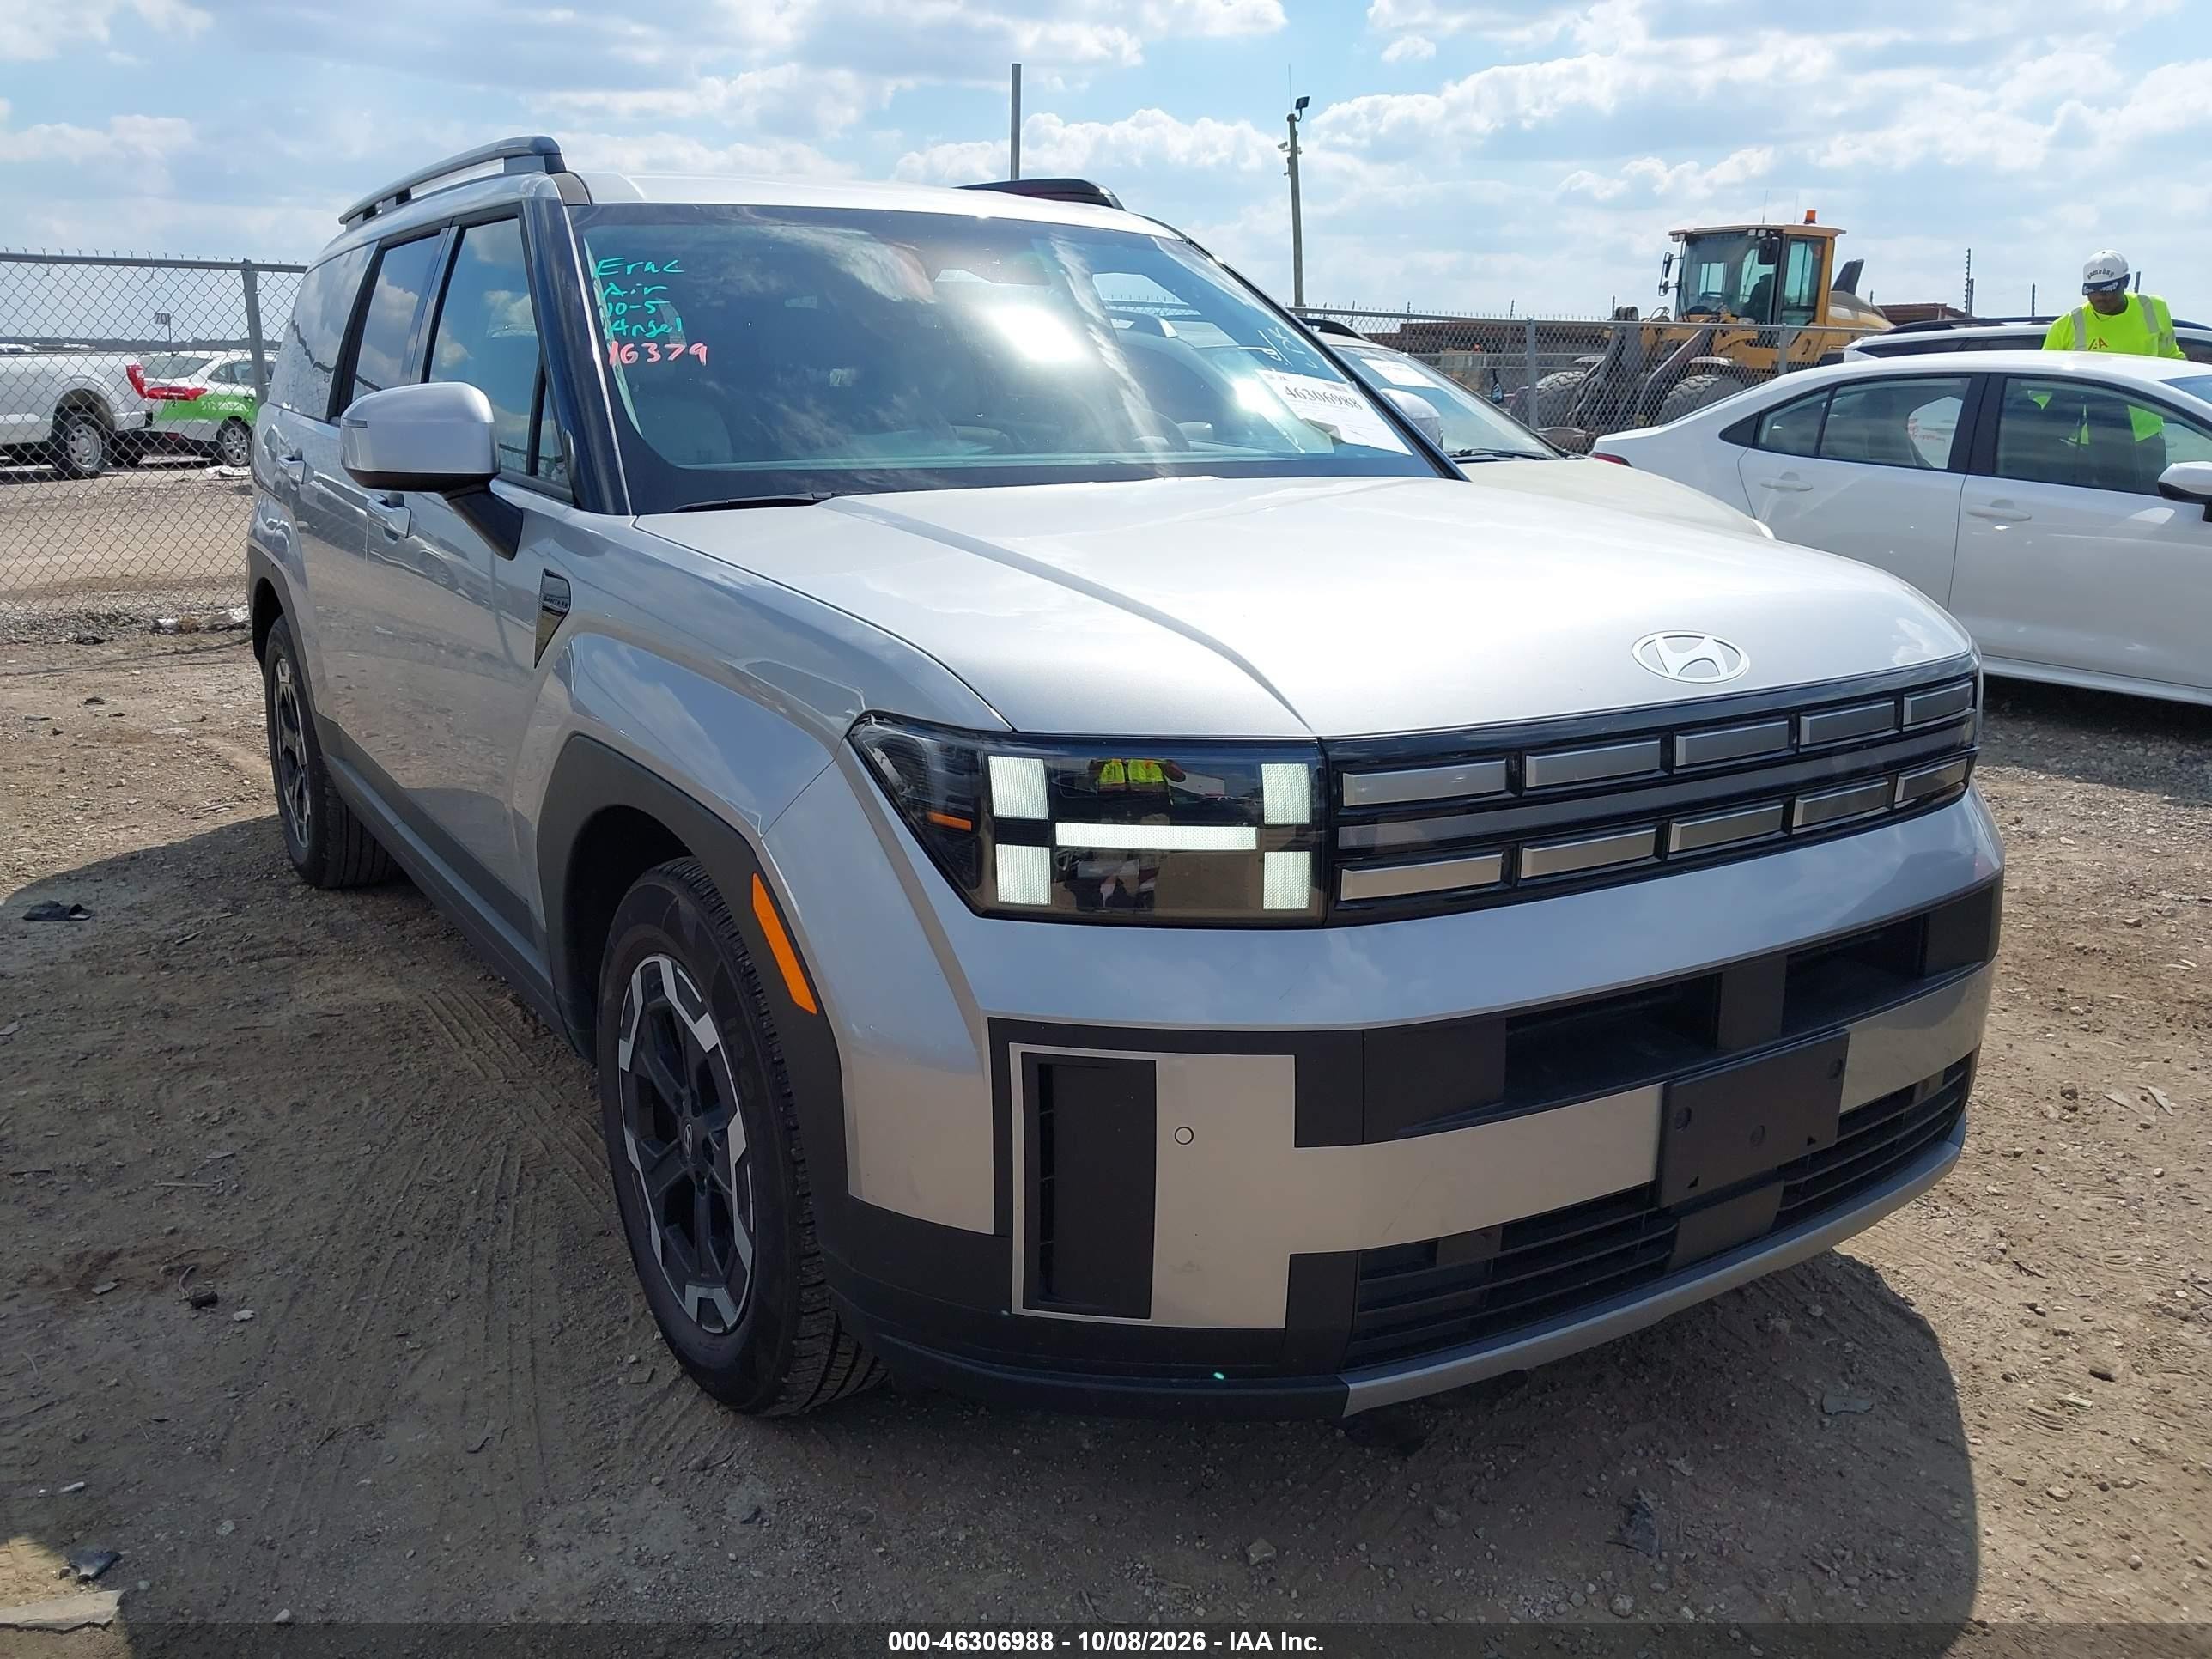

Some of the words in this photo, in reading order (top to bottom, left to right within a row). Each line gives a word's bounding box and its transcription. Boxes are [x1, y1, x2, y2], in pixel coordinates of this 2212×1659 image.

[606, 301, 671, 317] 10-5
[608, 340, 708, 367] 16379
[1285, 385, 1364, 410] 46306988
